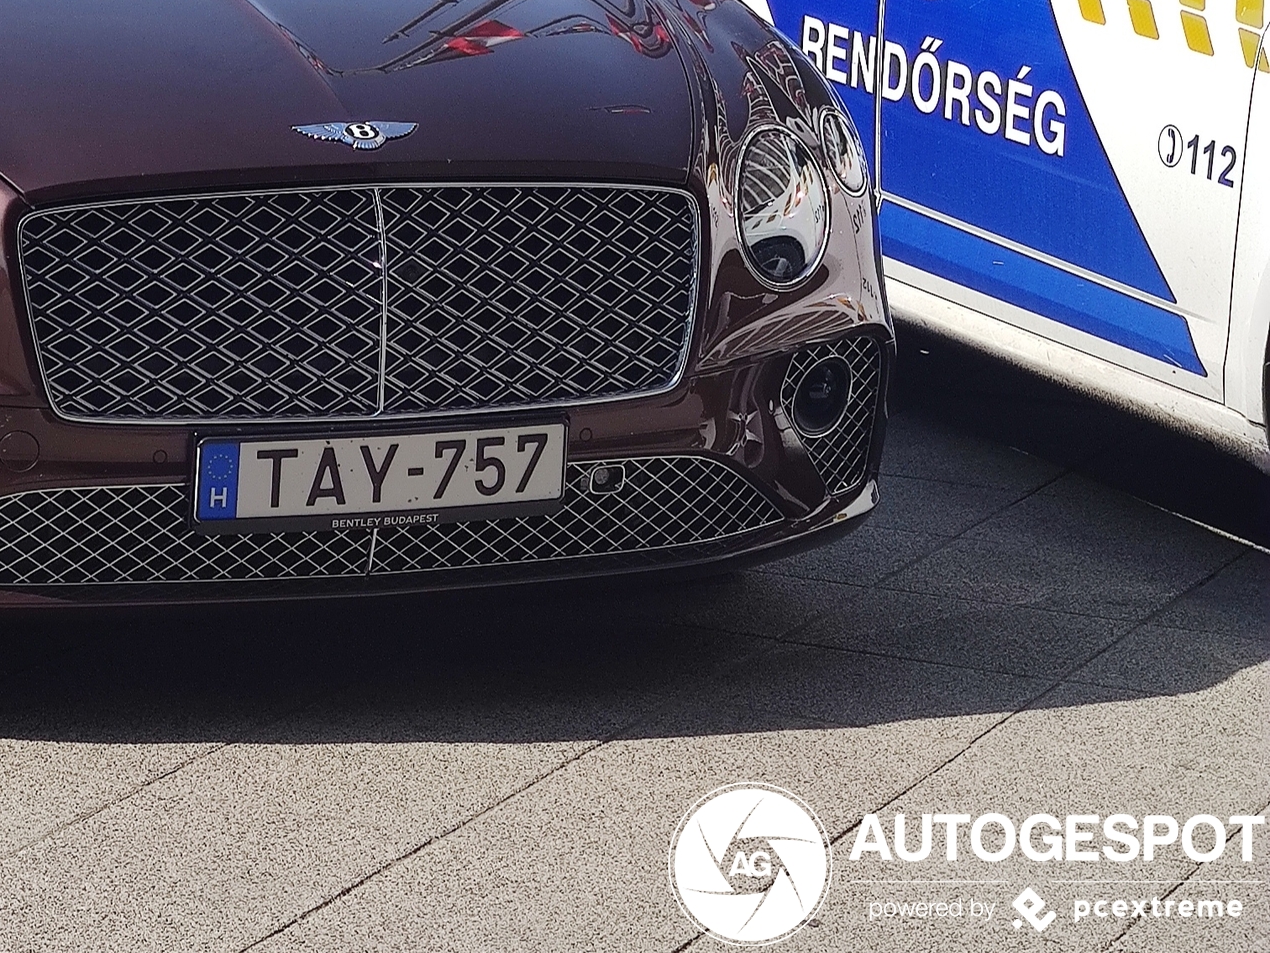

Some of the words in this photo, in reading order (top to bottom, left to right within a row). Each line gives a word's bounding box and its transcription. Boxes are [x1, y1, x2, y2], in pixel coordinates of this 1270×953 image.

[802, 15, 1067, 157] RENDŐRSÉG
[1186, 134, 1238, 188] 112
[210, 487, 228, 508] H
[256, 433, 548, 508] TAY-757
[332, 517, 381, 528] BENTLEY
[383, 514, 439, 525] BUDAPEST
